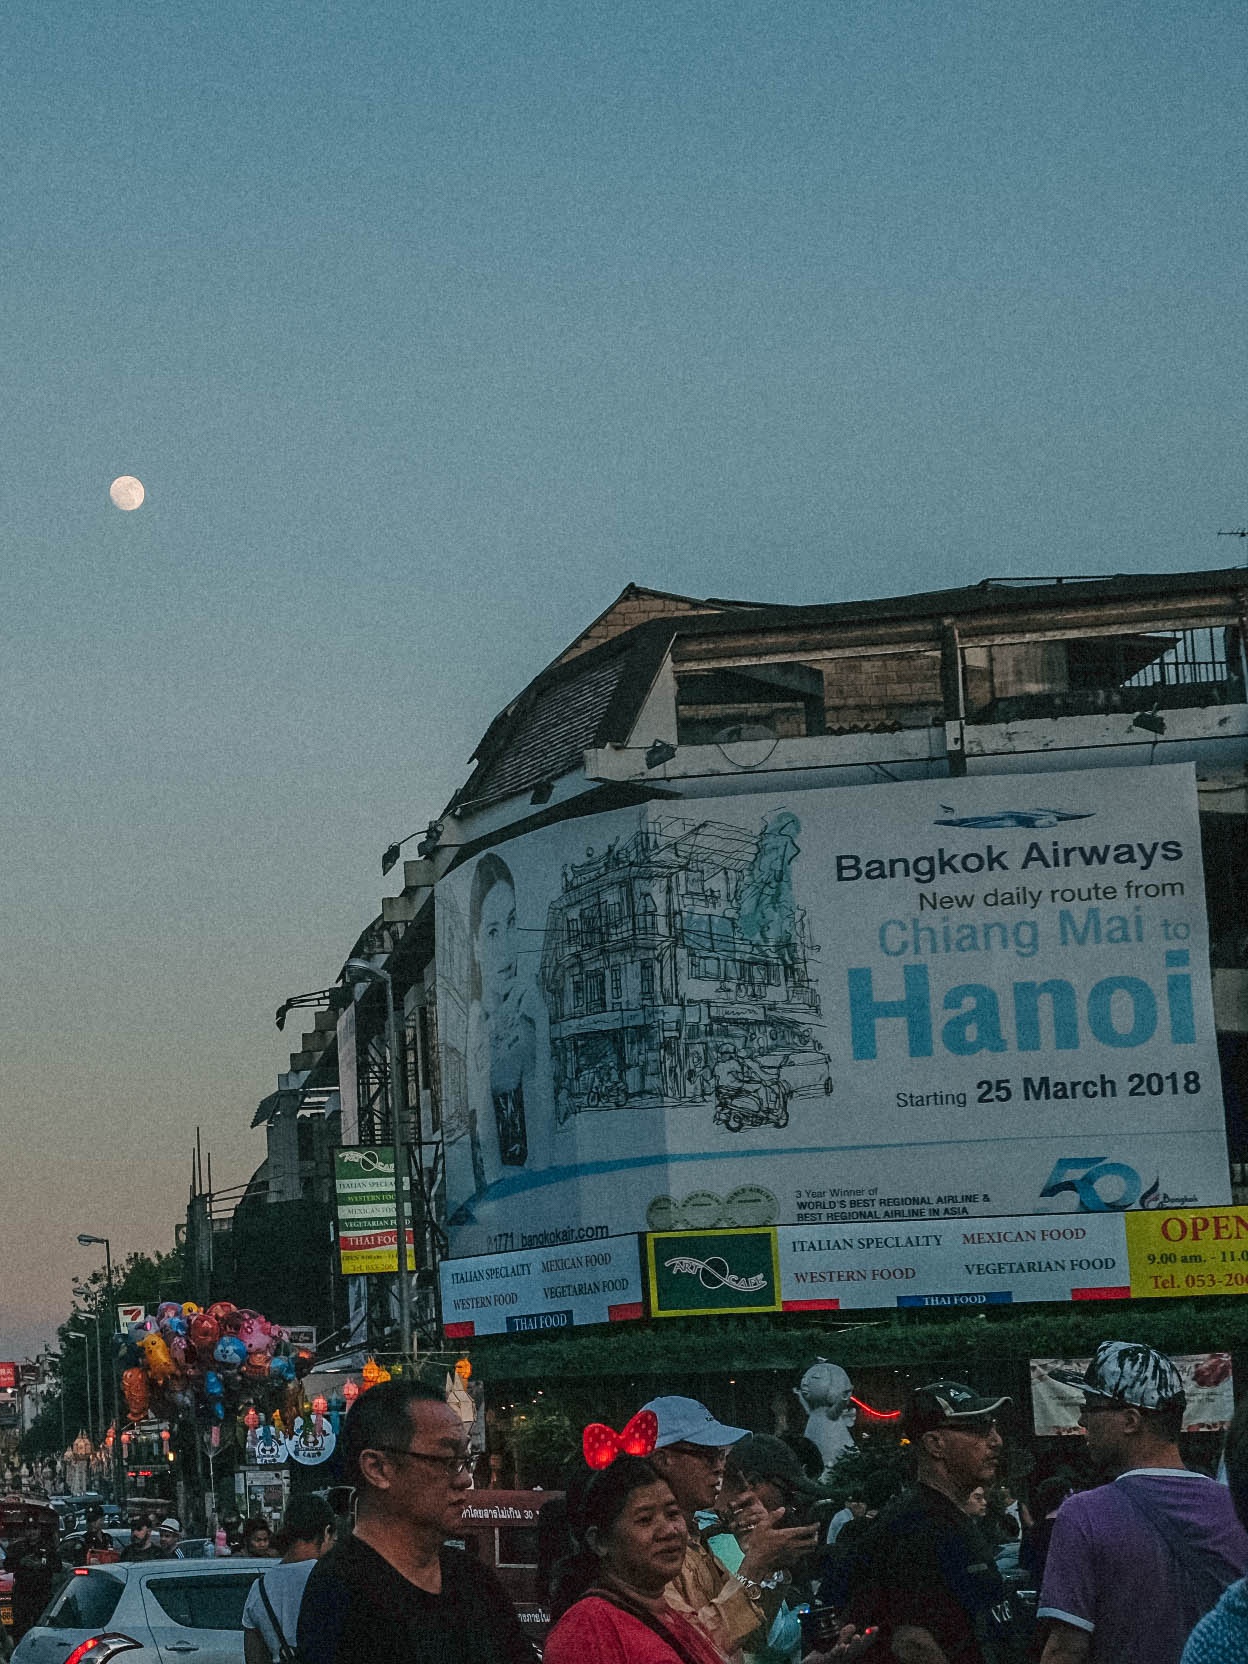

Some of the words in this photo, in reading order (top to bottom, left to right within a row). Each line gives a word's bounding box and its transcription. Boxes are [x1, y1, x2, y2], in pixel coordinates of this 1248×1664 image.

[836, 845, 1009, 884] Bangkok
[1021, 840, 1184, 871] Airways
[920, 891, 974, 911] New
[983, 886, 1042, 909] daily
[1050, 881, 1117, 903] route
[1126, 878, 1185, 899] from
[879, 915, 1040, 957] Chiang
[1059, 904, 1143, 946] Mai
[1162, 917, 1191, 941] to
[847, 948, 1197, 1061] Hanoi
[897, 1090, 967, 1109] Starting
[976, 1078, 1013, 1103] 25
[1023, 1073, 1117, 1101] March
[1127, 1070, 1201, 1097] 2018
[795, 1189, 802, 1199] 3
[805, 1188, 826, 1198] Year
[829, 1187, 865, 1198] Winner
[797, 1200, 847, 1210] WORLD'S
[850, 1198, 876, 1208] BEST
[879, 1196, 932, 1207] REGIONAL
[936, 1194, 980, 1204] AIRLINE
[797, 1212, 824, 1222] BEST
[826, 1210, 881, 1221] REGIONAL
[883, 1208, 926, 1219] AIRLINE
[928, 1207, 940, 1217] IN
[943, 1206, 969, 1216] ASIA
[521, 1221, 610, 1248] bangkokair.com
[962, 1230, 1036, 1245] MEXICAN
[1041, 1228, 1087, 1242] FOOD
[792, 1238, 853, 1252] ITALIAN
[541, 1255, 583, 1273] MEXICAN
[585, 1252, 612, 1268] FOOD
[672, 1259, 703, 1275] ART
[964, 1258, 1067, 1276] VEGETARIAN
[1070, 1257, 1116, 1272] FOOD
[1147, 1253, 1177, 1265] 9.00
[1180, 1253, 1207, 1264] am.
[451, 1269, 485, 1285] ITALIAN
[794, 1269, 867, 1284] WESTERN
[872, 1267, 916, 1281] FOOD
[1151, 1274, 1181, 1289] Tel.
[543, 1280, 600, 1300] VEGETARIAN
[602, 1278, 629, 1293] FOOD
[453, 1294, 492, 1311] WESTERN
[494, 1292, 518, 1307] FOOD
[924, 1296, 952, 1306] THAI
[954, 1294, 987, 1304] FOOD
[514, 1316, 537, 1331] THAI
[539, 1313, 567, 1329] FOOD
[523, 1509, 534, 1519] 30
